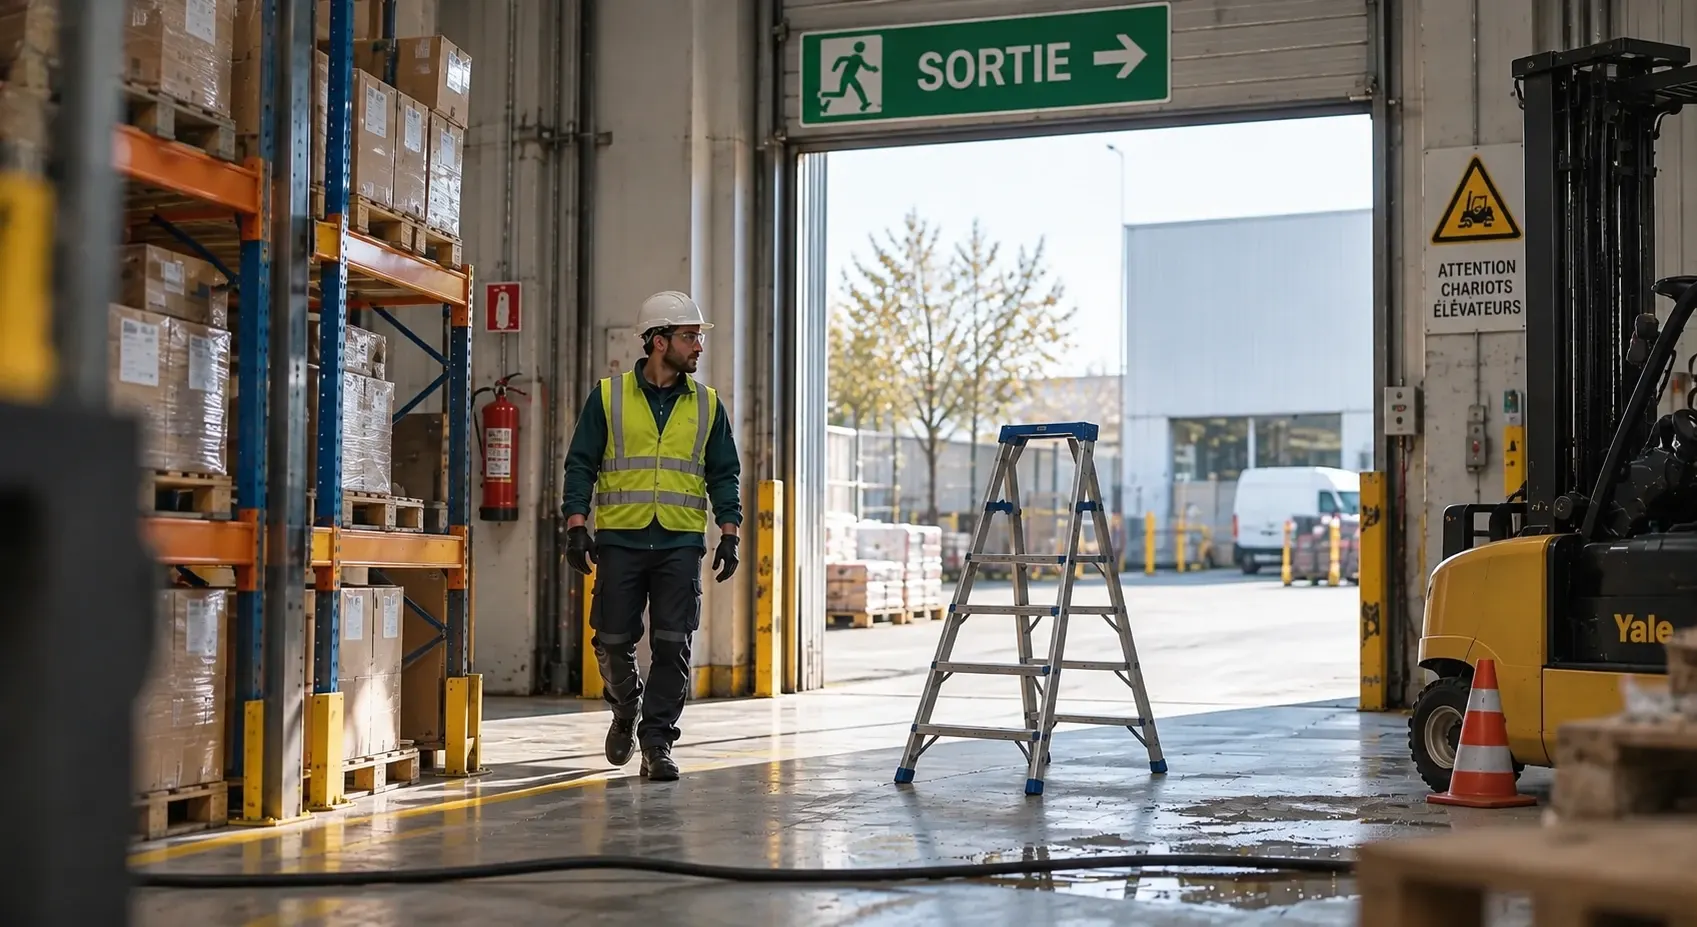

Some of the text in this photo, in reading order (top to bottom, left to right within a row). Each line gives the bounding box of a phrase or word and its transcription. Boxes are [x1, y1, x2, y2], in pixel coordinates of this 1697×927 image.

[917, 42, 1071, 91] SORTIE
[1438, 260, 1516, 278] ATTENTION
[1441, 279, 1513, 297] CHARIOTS
[1614, 614, 1674, 644] Yale
